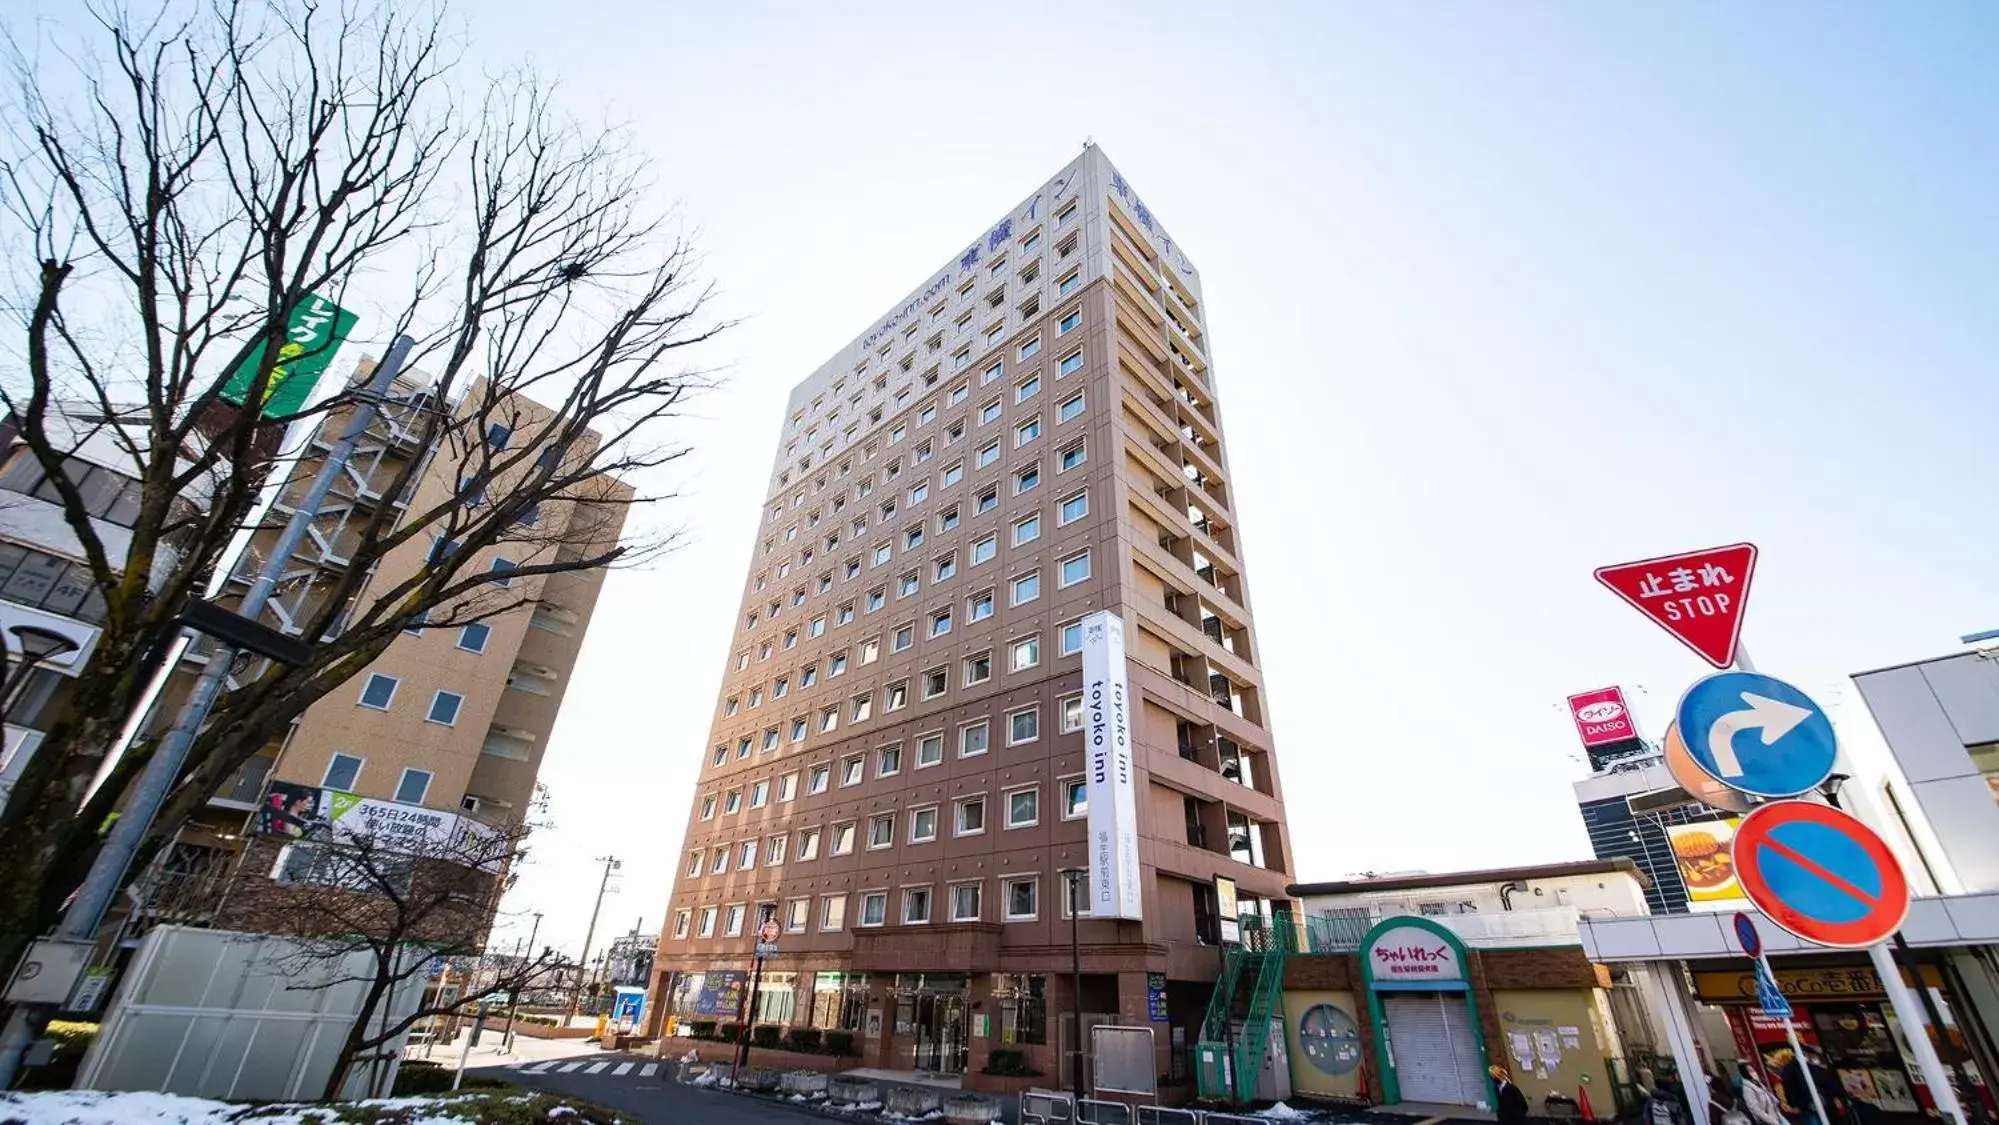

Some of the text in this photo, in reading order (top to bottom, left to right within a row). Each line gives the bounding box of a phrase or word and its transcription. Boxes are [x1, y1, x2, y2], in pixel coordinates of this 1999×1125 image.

[1640, 562, 1735, 598] 止まれ
[1663, 593, 1730, 620] STOP
[1583, 705, 1620, 719] ダイソー
[1090, 680, 1107, 784] toyoko inn
[1115, 682, 1129, 785] toyoko inn
[1587, 721, 1626, 735] DAISO
[358, 803, 442, 829] 365日24時間
[1375, 944, 1450, 962] ちゃいれっく
